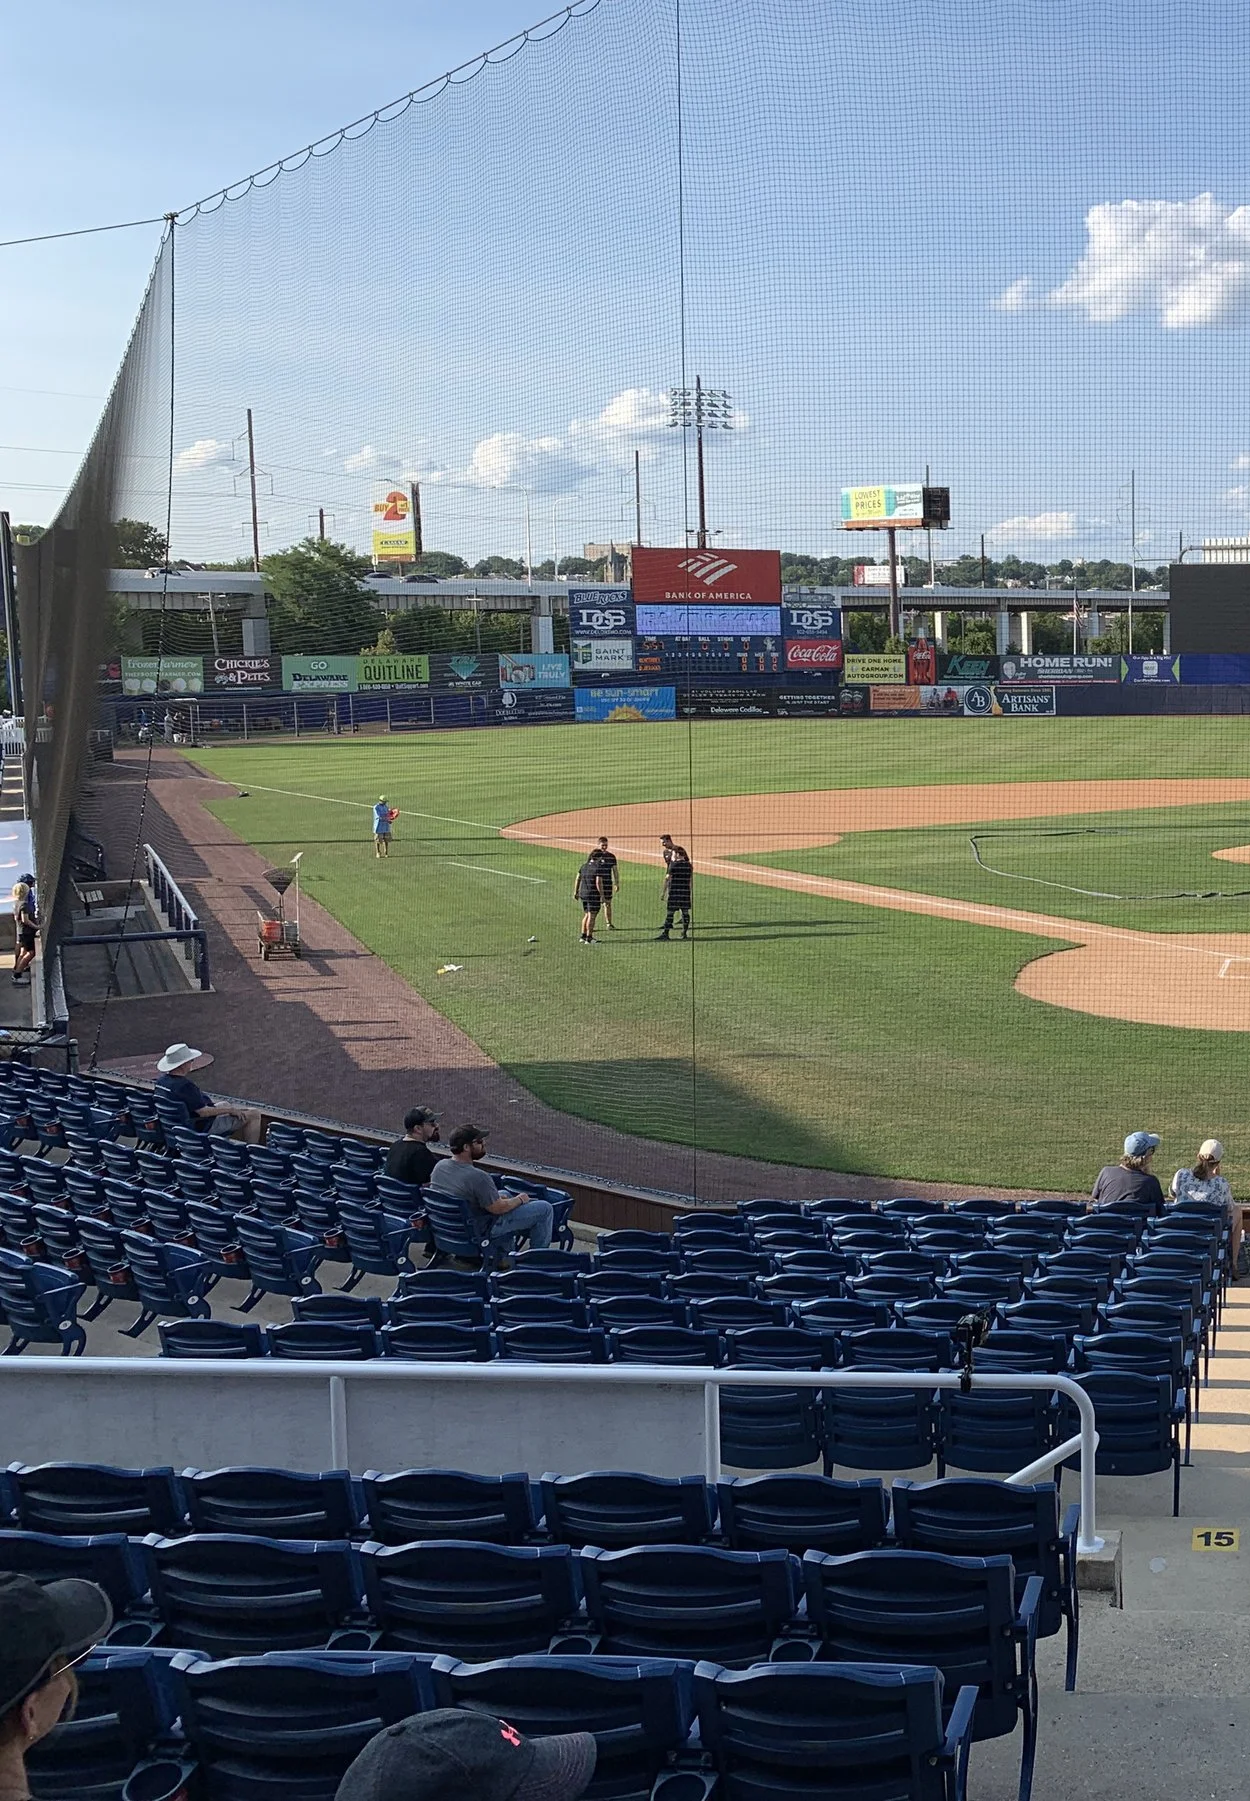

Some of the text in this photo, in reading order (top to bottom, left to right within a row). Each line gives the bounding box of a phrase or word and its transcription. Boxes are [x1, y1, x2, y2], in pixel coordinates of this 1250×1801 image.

[854, 490, 880, 500] LOWEST
[374, 504, 389, 512] BUY
[856, 500, 882, 510] PRICES
[788, 644, 840, 662] Coca-Cola
[128, 660, 158, 669] frozen
[214, 658, 270, 670] CHICKIE'S
[310, 662, 328, 670] GO
[947, 656, 990, 675] KEEN
[1020, 657, 1112, 668] HOME RUN!
[228, 670, 270, 684] & PETE'S
[364, 664, 423, 681] QUITLINE
[292, 674, 348, 682] DELAWARE
[292, 681, 348, 690] EXPRESS
[970, 691, 986, 708] AB
[1011, 703, 1039, 712] BANK
[1197, 1531, 1235, 1547] 15
